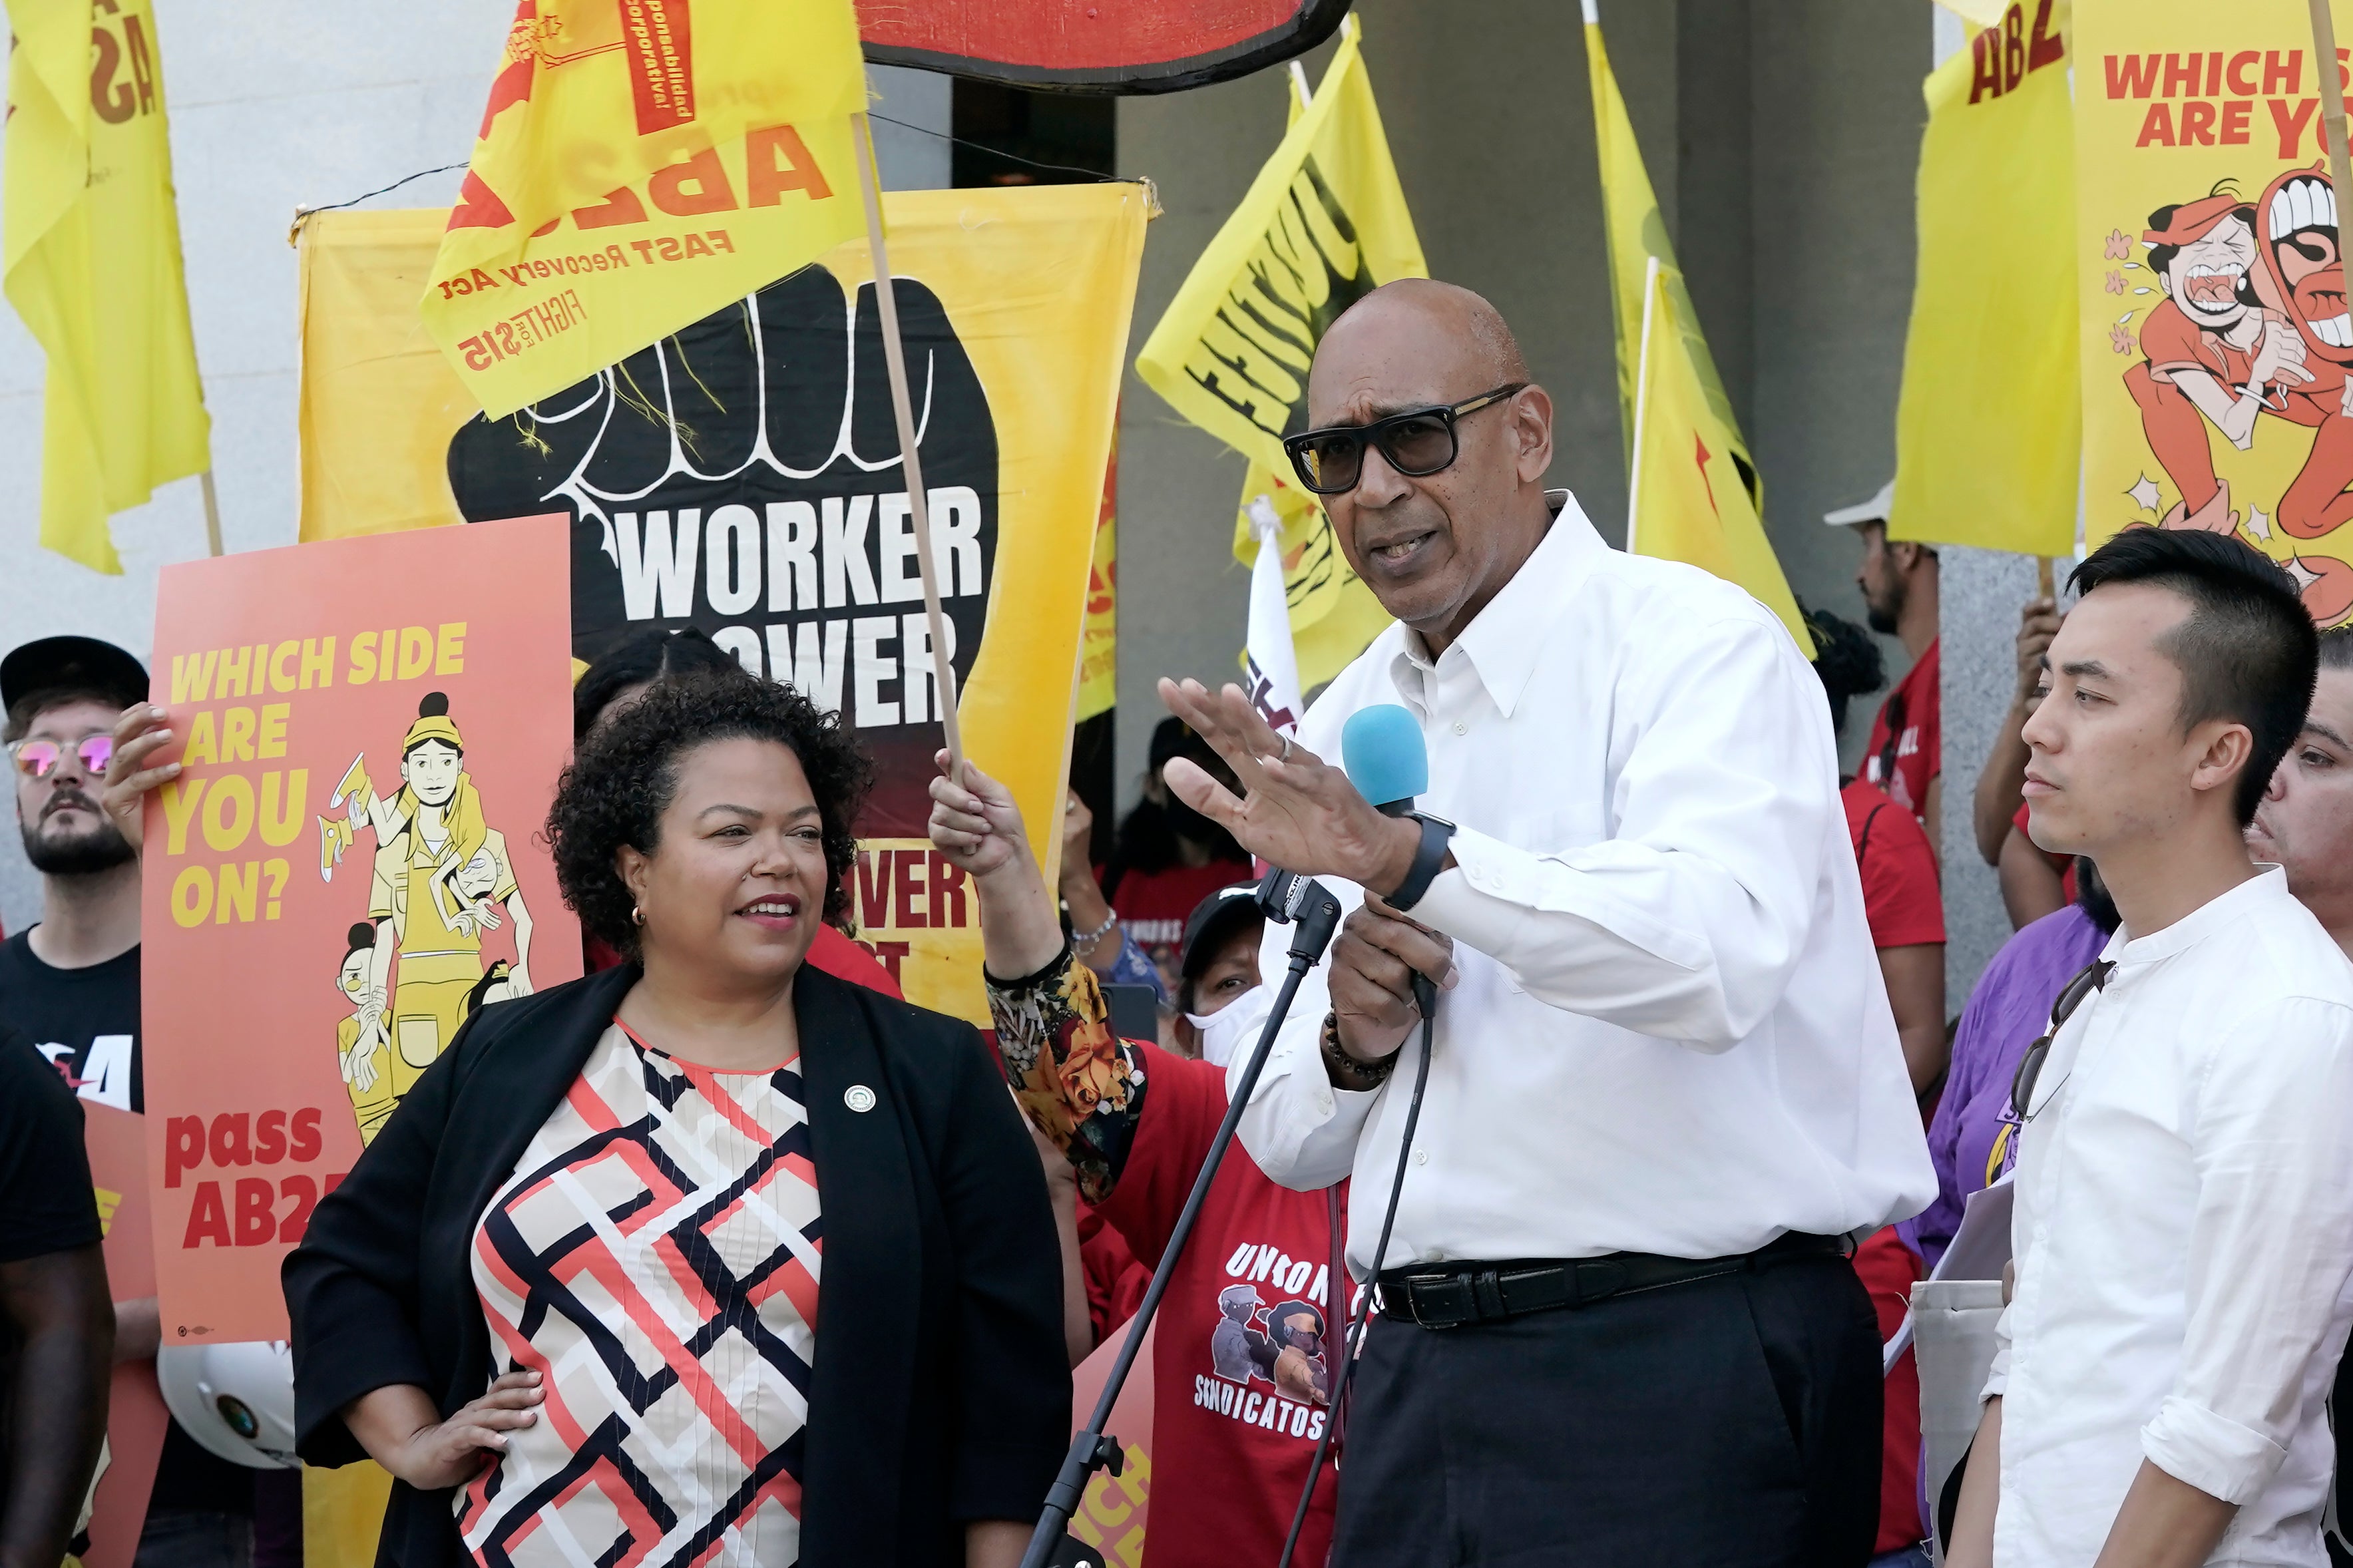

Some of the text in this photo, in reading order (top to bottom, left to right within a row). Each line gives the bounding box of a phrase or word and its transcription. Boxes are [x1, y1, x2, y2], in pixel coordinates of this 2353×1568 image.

[2104, 50, 2303, 100] WHICH
[2135, 100, 2254, 147] ARE
[613, 485, 983, 622] WORKER
[170, 622, 468, 705] WHICH SIDE
[181, 703, 291, 767] ARE
[160, 768, 310, 856] YOU
[170, 859, 290, 928] ON?
[164, 1107, 323, 1189] pass
[182, 1173, 350, 1250] AB2
